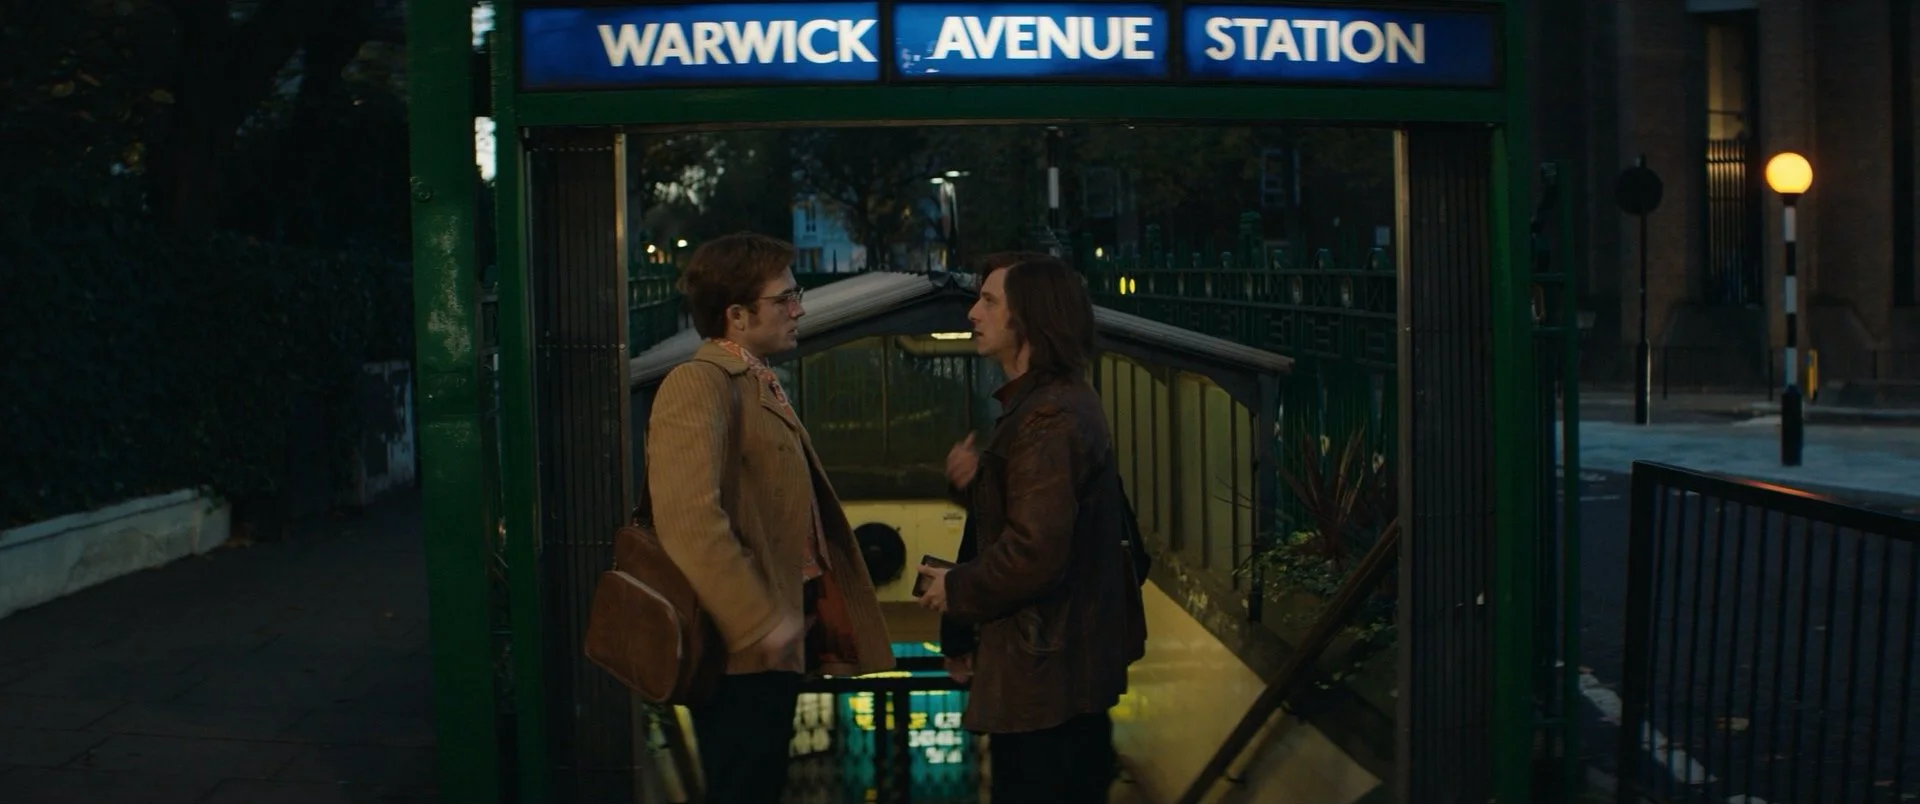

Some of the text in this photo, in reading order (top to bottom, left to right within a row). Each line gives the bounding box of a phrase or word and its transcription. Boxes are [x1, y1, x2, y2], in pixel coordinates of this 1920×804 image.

[598, 15, 1425, 66] WARWICK AVENUE STATION
